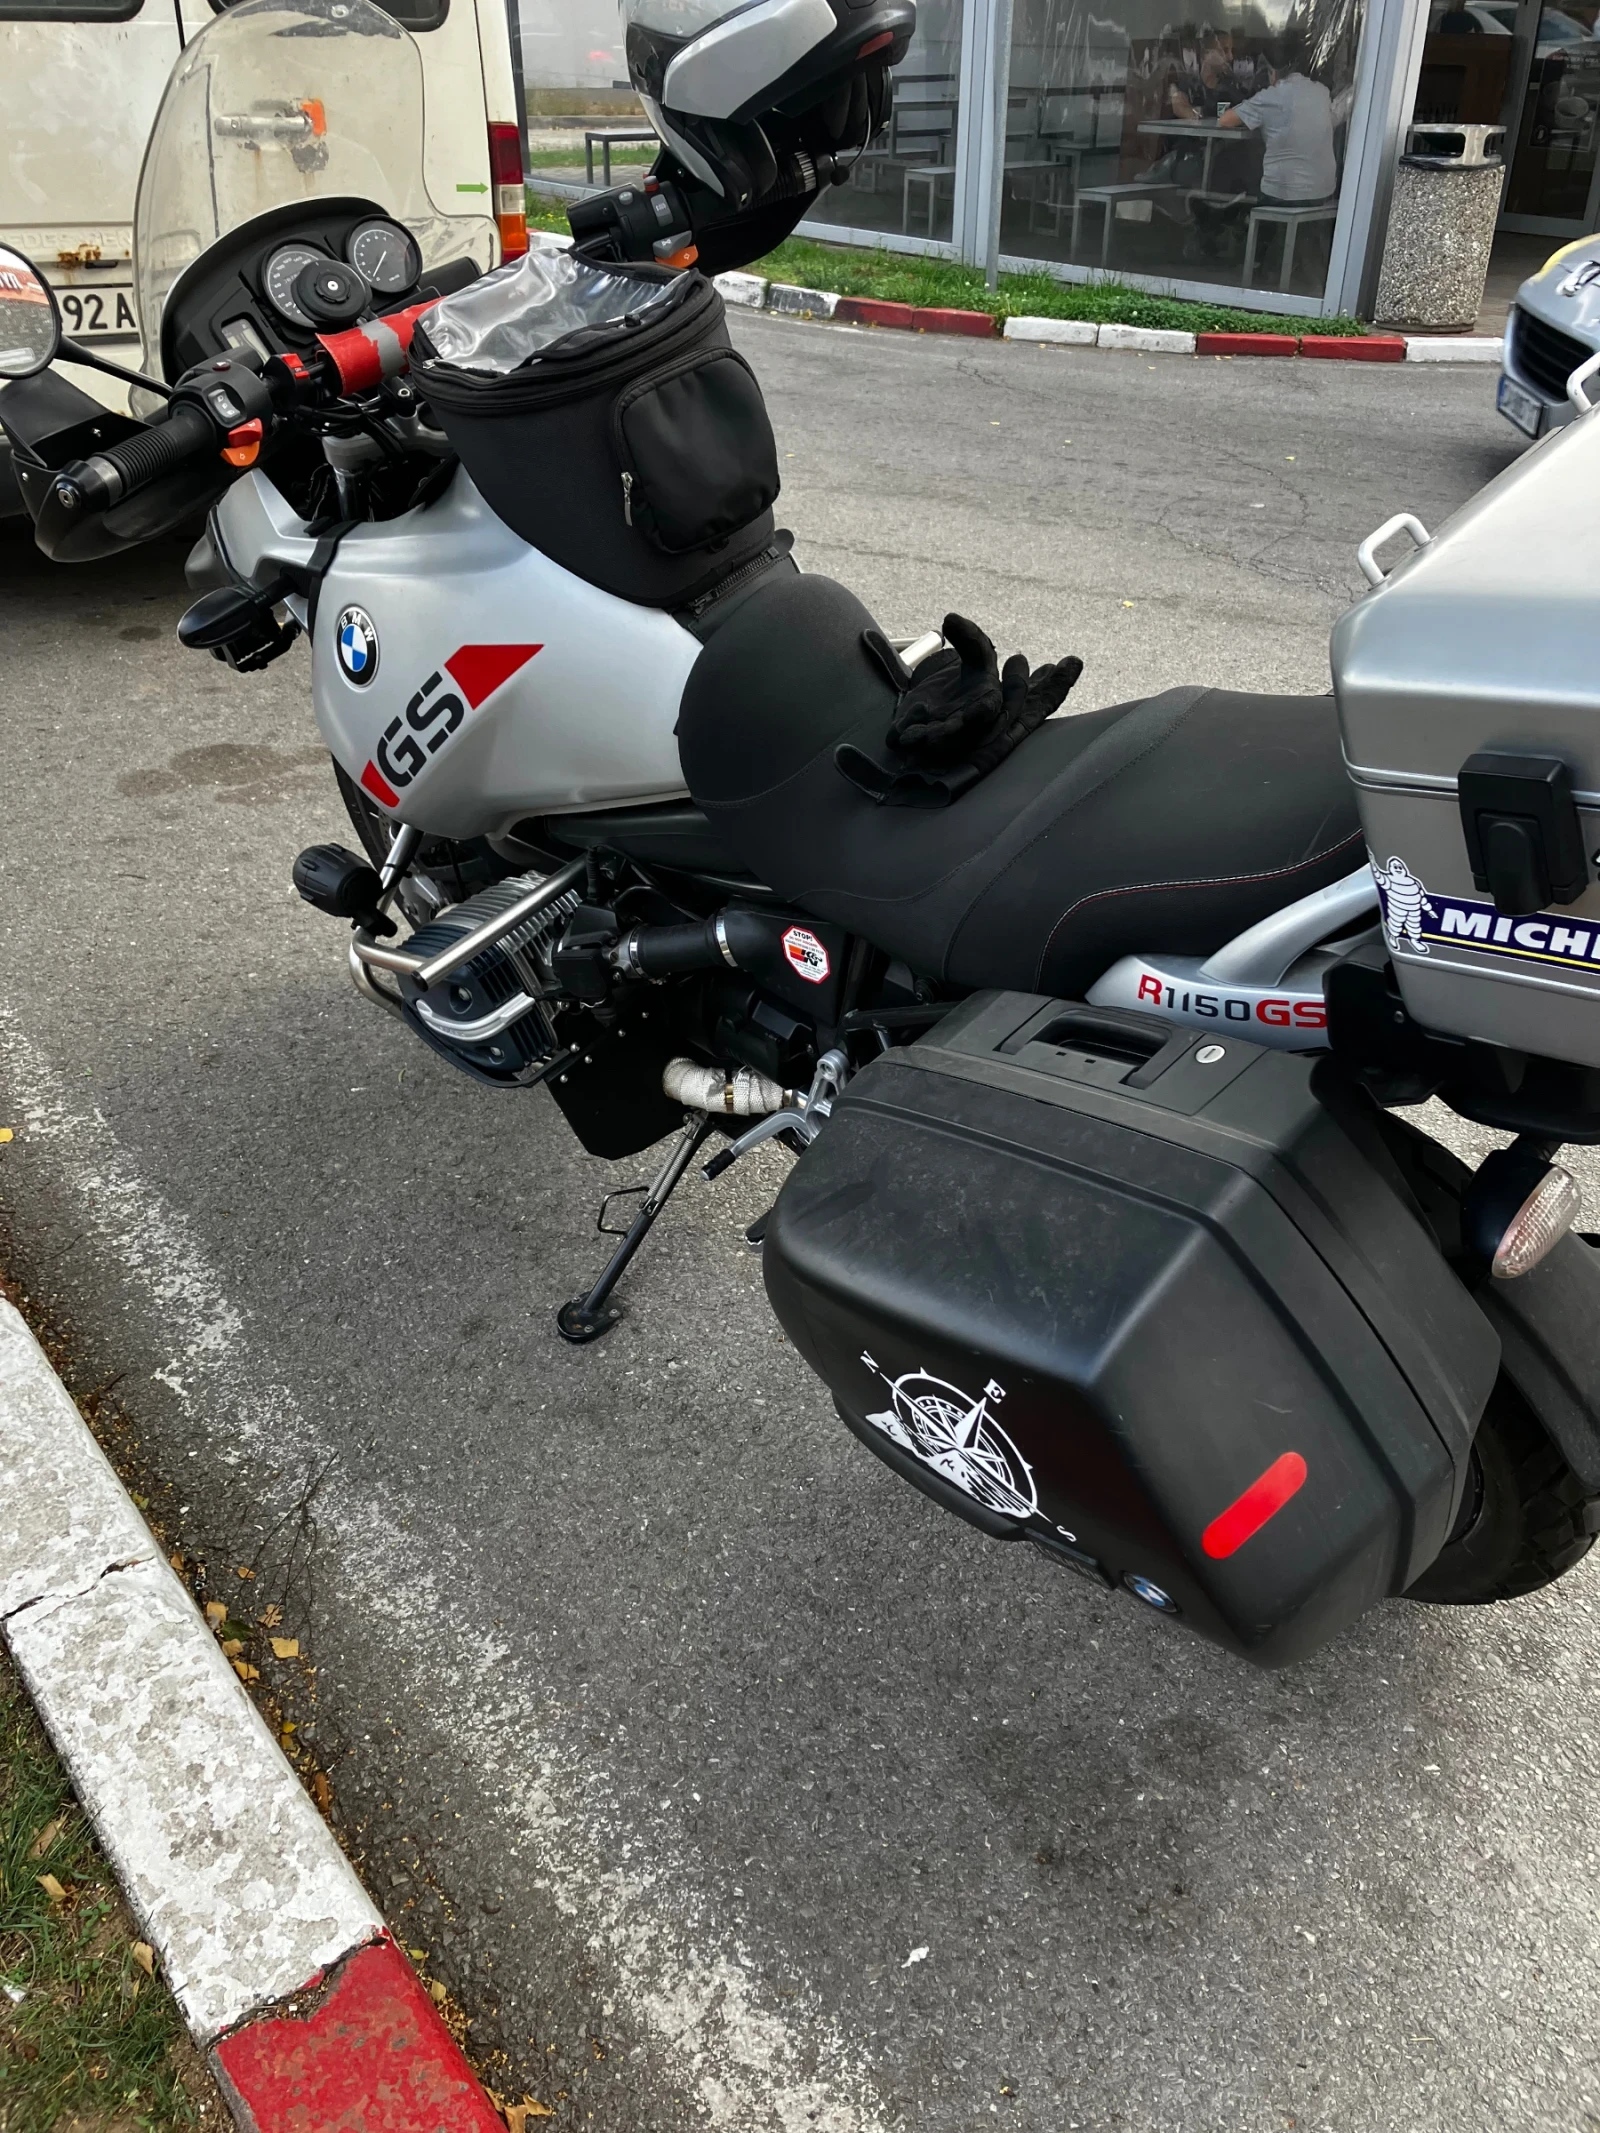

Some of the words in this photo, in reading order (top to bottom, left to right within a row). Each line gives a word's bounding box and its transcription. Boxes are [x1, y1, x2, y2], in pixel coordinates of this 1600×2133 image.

[61, 294, 108, 331] 92
[116, 292, 137, 329] A
[340, 611, 374, 642] BMW
[376, 670, 465, 788] GS
[1137, 974, 1328, 1029] R1150GS
[860, 1350, 880, 1373] N
[983, 1378, 1007, 1404] E
[1056, 1525, 1077, 1542] S
